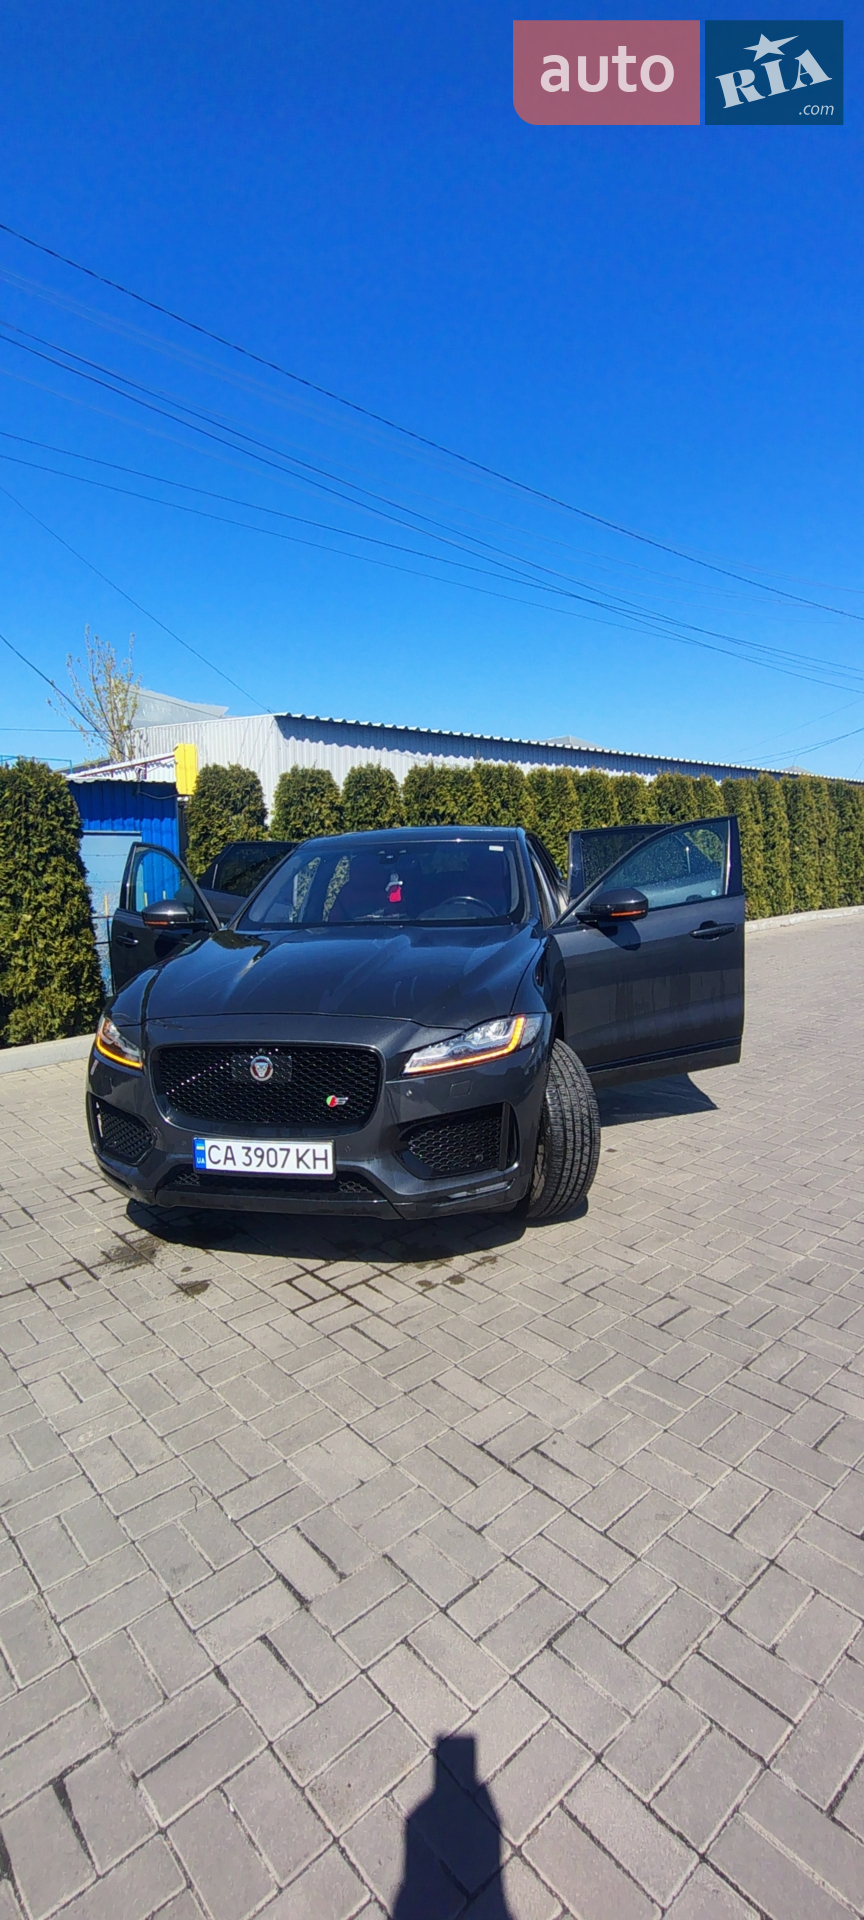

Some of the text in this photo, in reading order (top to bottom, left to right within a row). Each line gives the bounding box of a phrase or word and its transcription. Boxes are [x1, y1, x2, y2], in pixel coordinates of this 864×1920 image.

[196, 1157, 206, 1165] UA
[207, 1144, 328, 1170] CA 3907 KH
